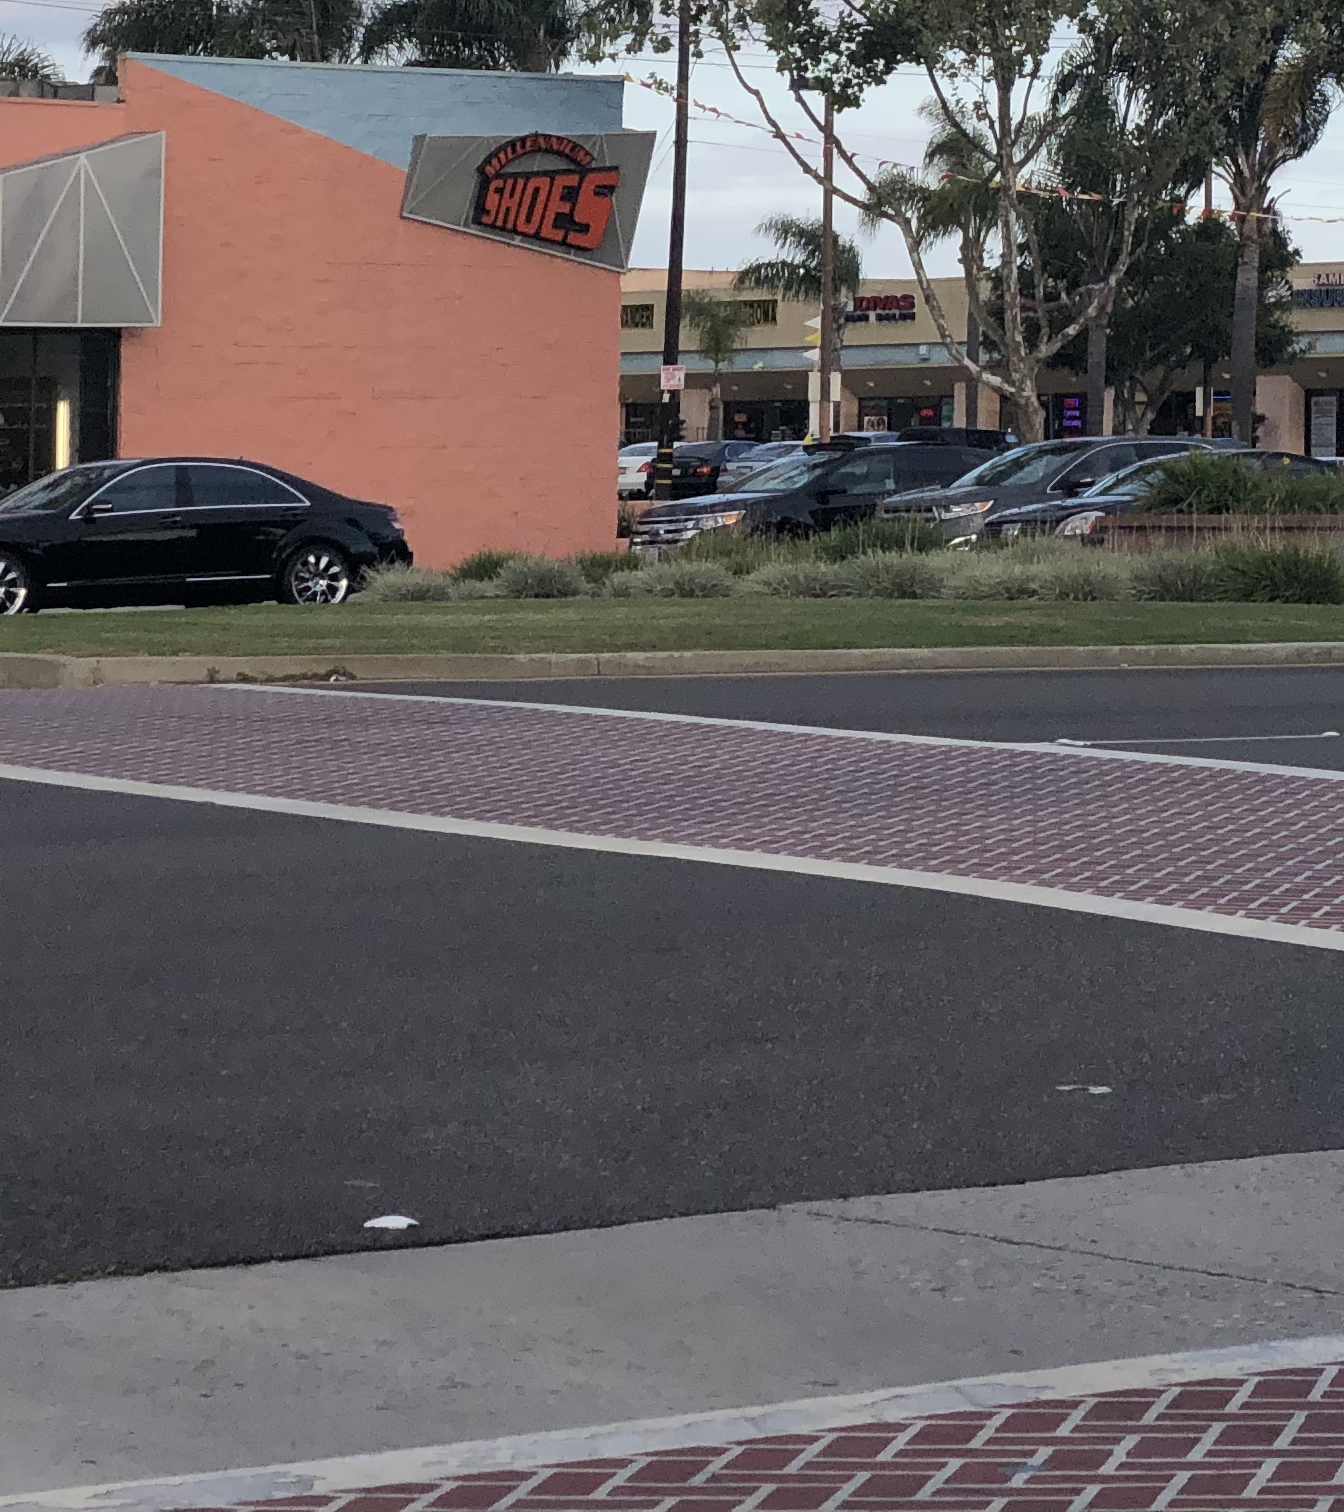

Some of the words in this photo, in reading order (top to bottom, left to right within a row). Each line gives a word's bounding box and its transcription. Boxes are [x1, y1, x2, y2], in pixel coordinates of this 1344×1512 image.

[484, 135, 593, 178] MILLENNIUM
[482, 170, 621, 250] SHOES
[854, 294, 915, 311] DIVAS
